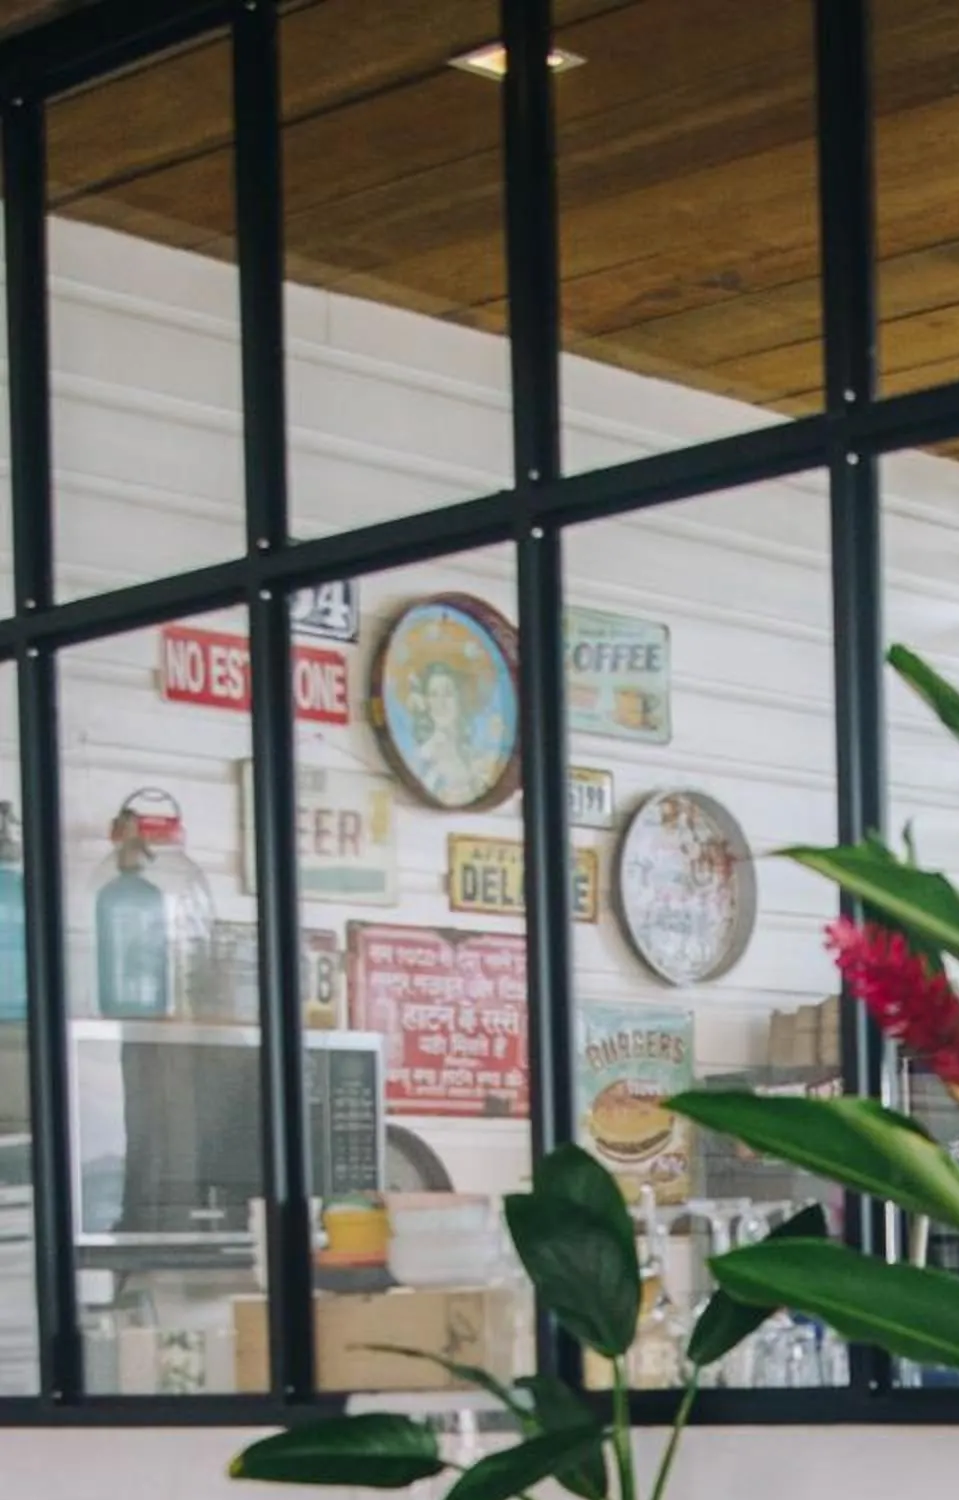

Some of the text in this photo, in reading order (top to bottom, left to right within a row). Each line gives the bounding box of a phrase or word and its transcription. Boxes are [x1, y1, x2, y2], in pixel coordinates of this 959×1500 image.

[166, 638, 205, 693] NO
[566, 640, 662, 675] OFFEE
[585, 1028, 686, 1074] BURGERS
